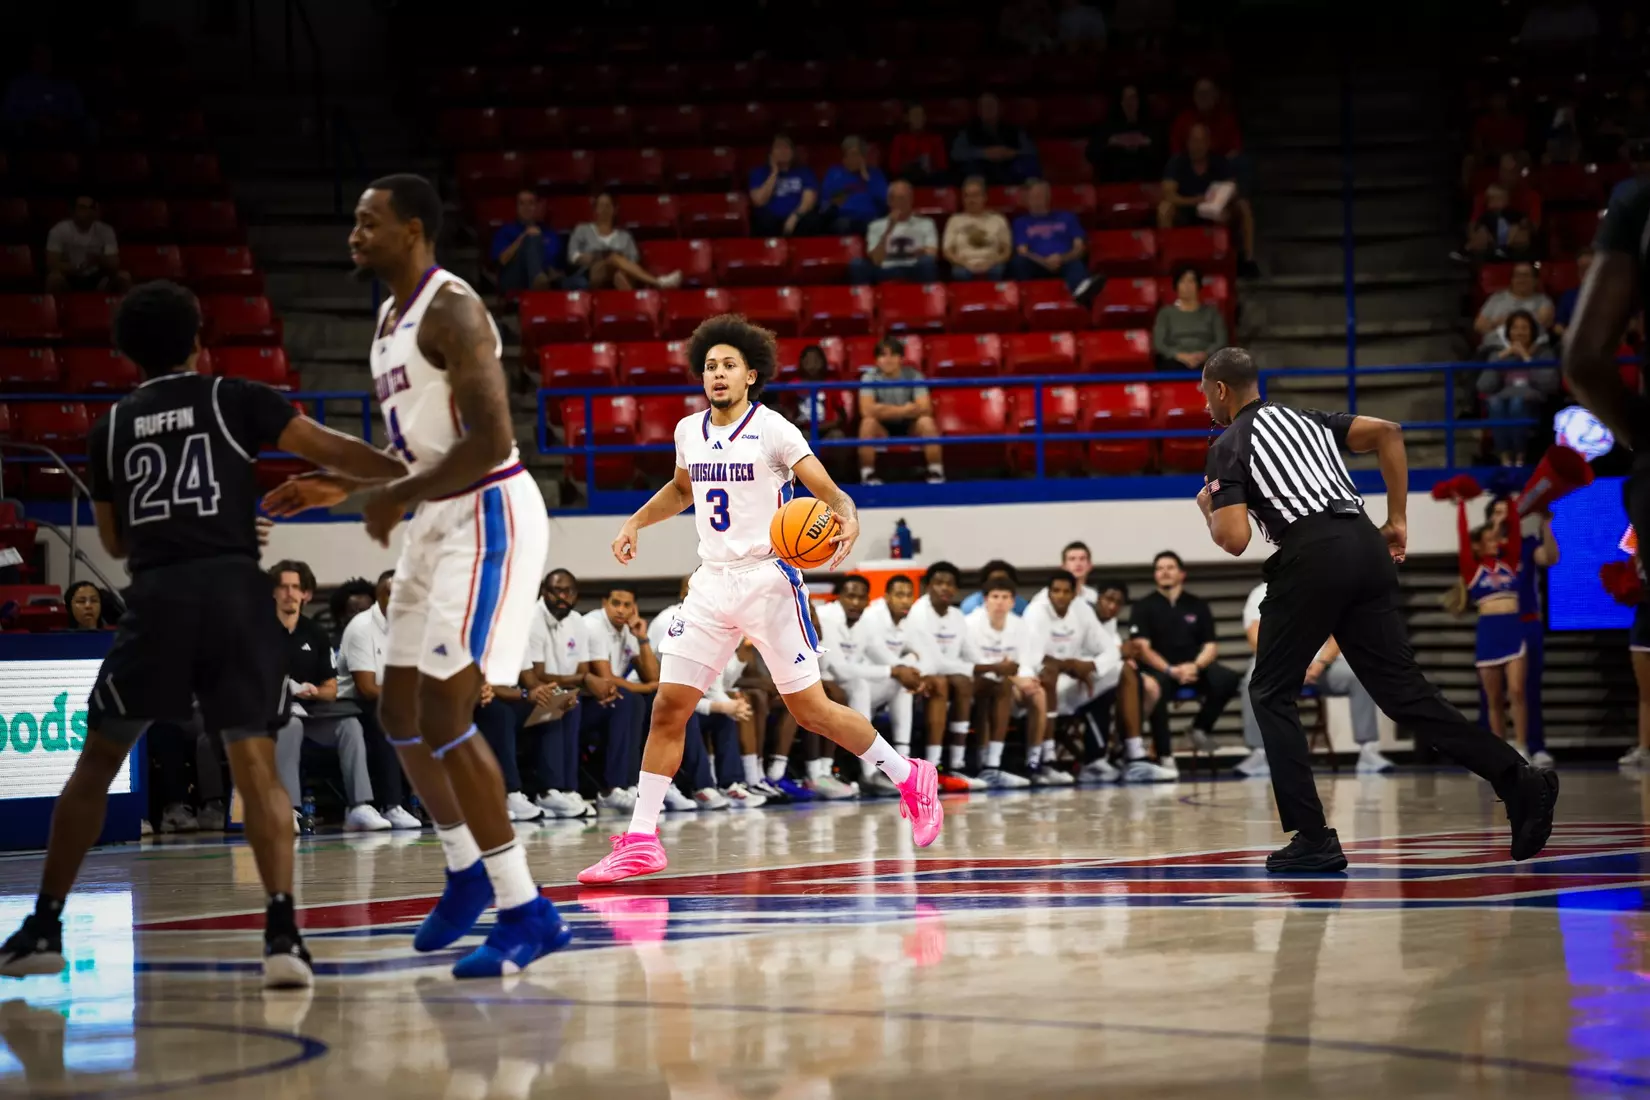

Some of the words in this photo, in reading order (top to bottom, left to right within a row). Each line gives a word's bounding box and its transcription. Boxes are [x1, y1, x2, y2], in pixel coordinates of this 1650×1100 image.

[134, 406, 195, 439] RUFFIN
[124, 433, 221, 526] 24
[729, 463, 755, 482] TECH
[706, 488, 731, 532] 3
[0, 691, 88, 754] ods
